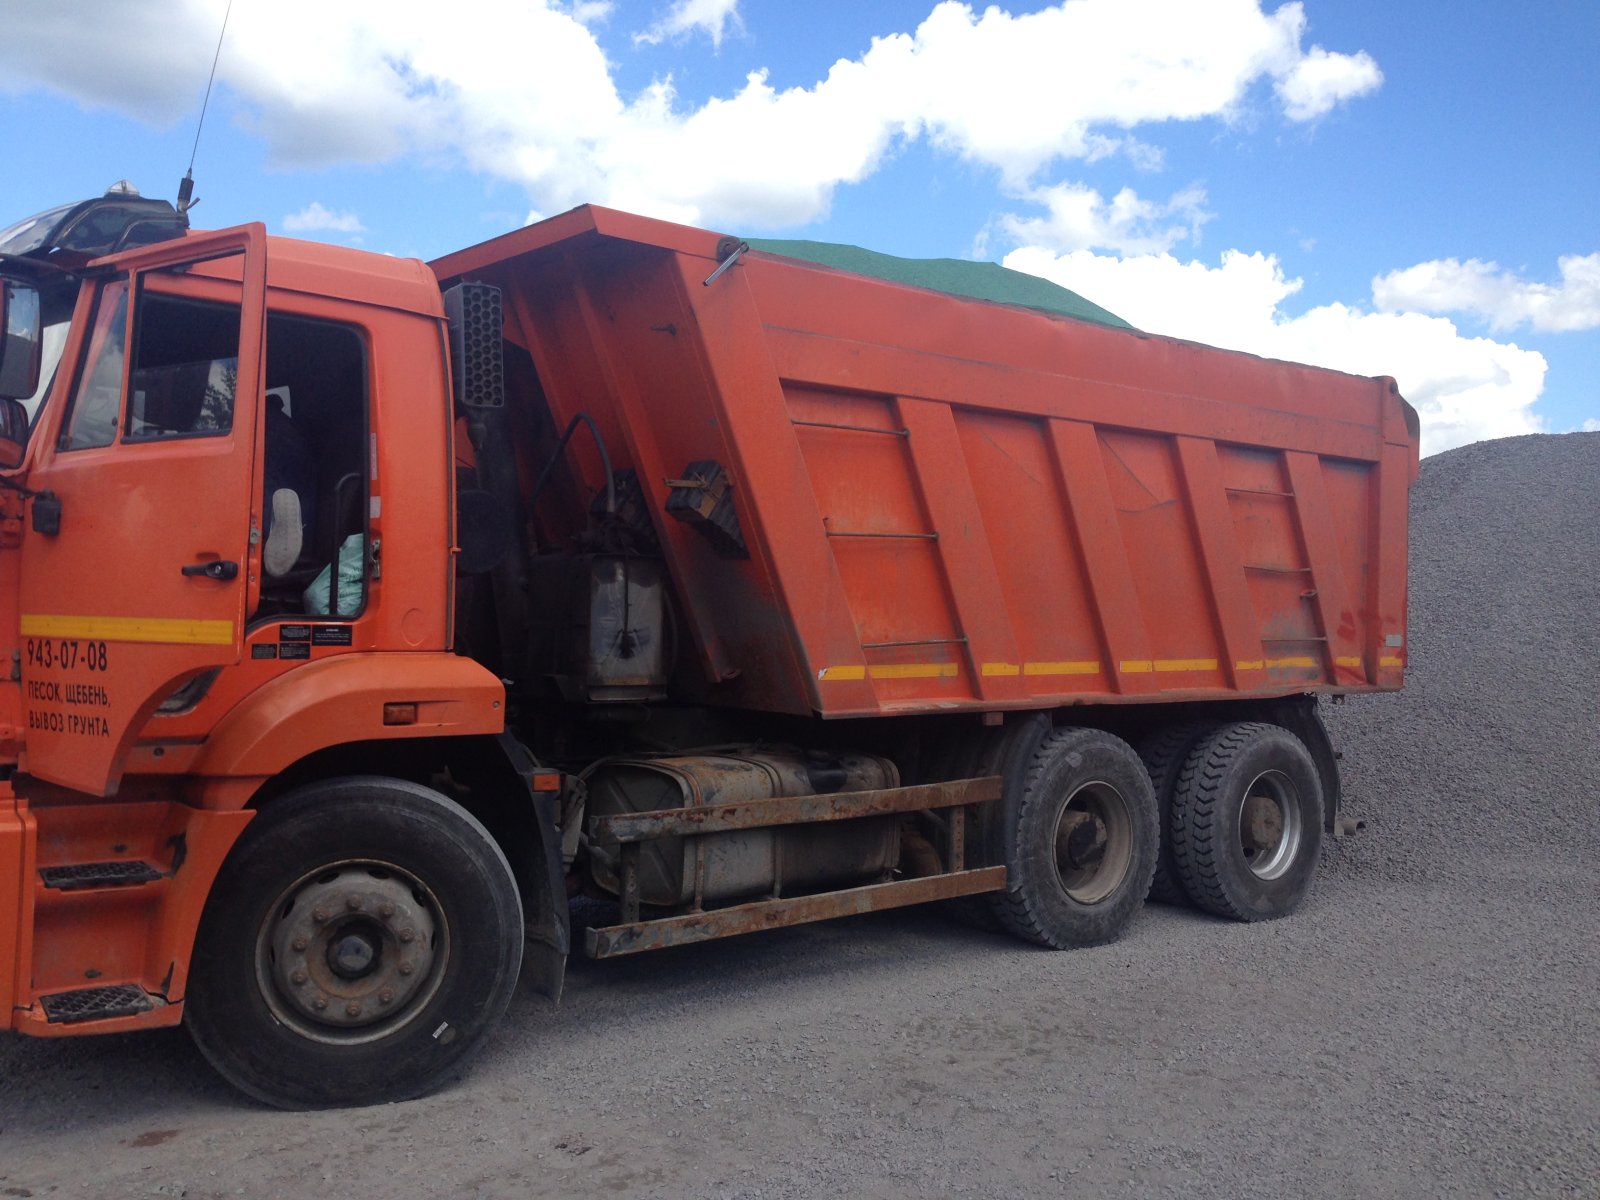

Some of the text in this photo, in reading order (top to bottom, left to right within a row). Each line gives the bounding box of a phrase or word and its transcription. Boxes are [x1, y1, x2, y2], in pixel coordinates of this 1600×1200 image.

[28, 639, 107, 671] 943-07-08
[65, 684, 111, 708] ЩЕБЕНЬ,
[29, 710, 109, 737] ВЫВОЗ ГРУНТА
